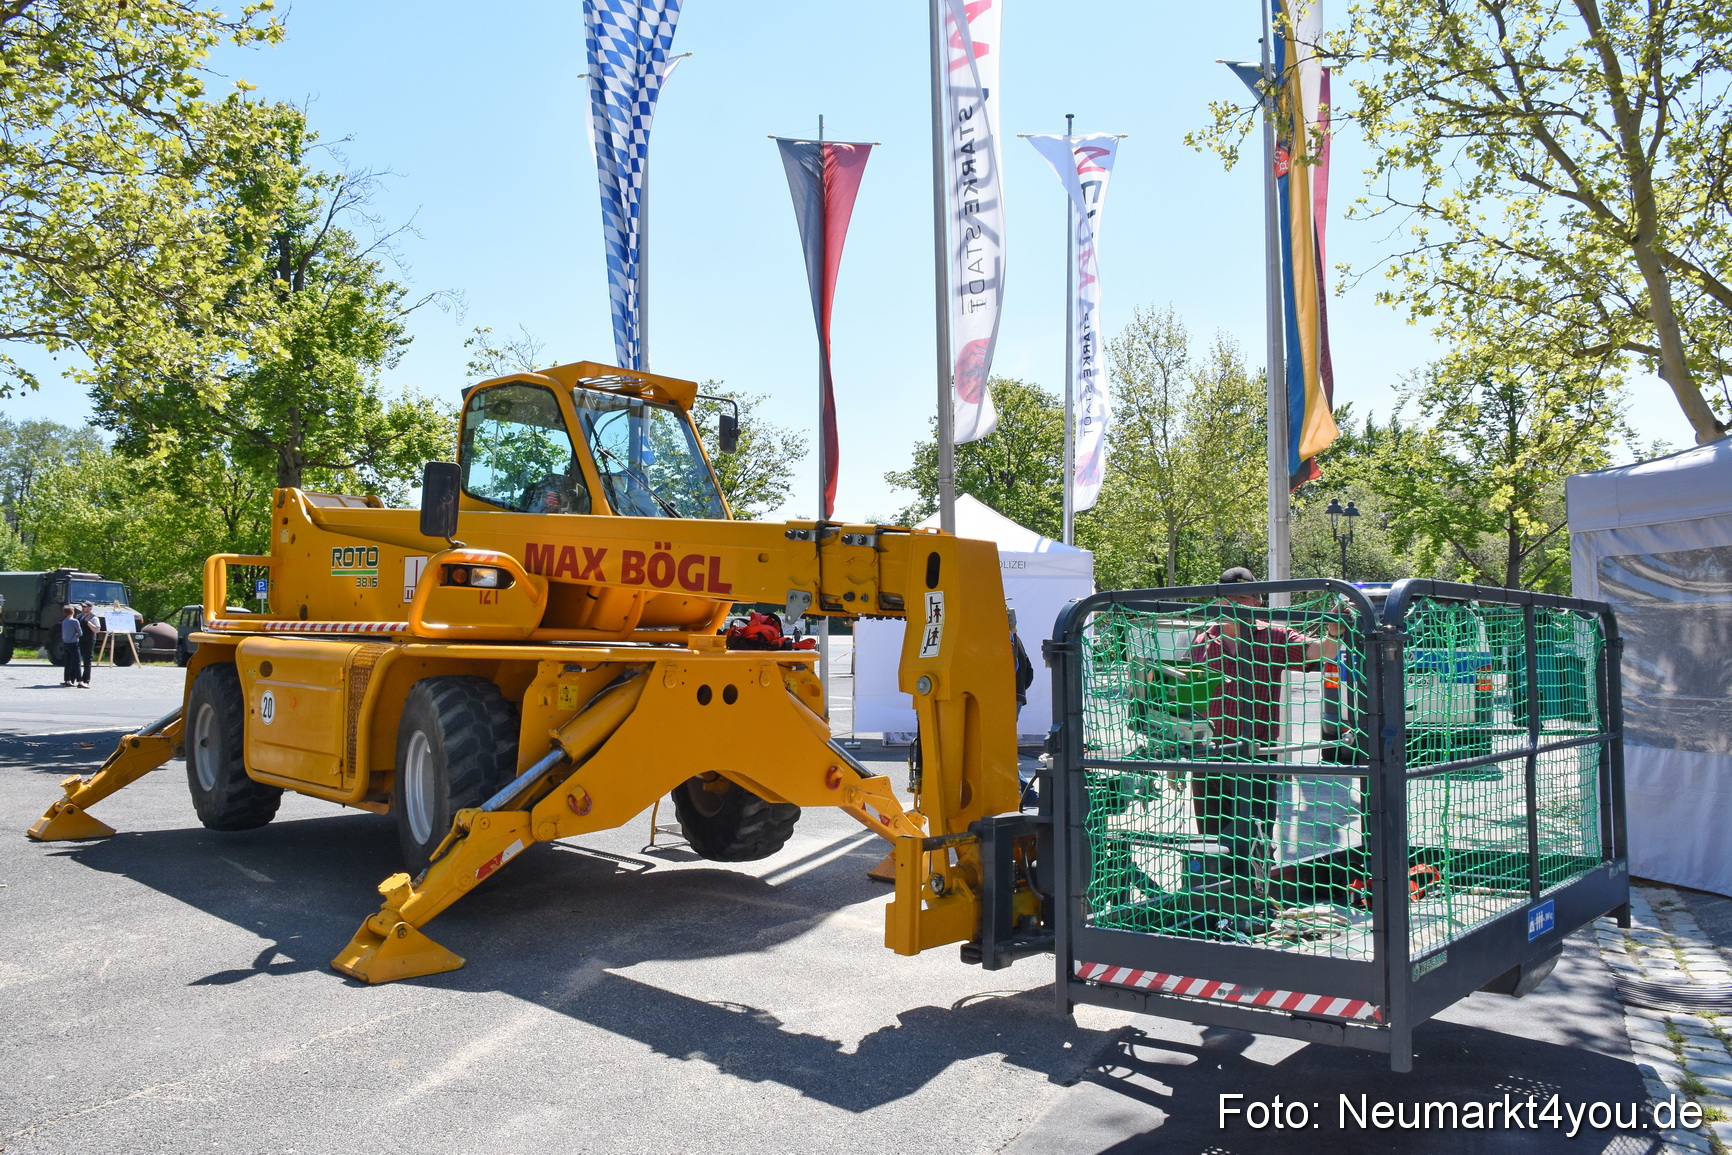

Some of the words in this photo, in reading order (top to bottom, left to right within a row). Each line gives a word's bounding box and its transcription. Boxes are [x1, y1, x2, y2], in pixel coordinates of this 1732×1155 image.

[331, 546, 379, 568] ROTO
[525, 542, 608, 582] MAX
[620, 541, 733, 595] BÖGL
[262, 696, 273, 719] 20
